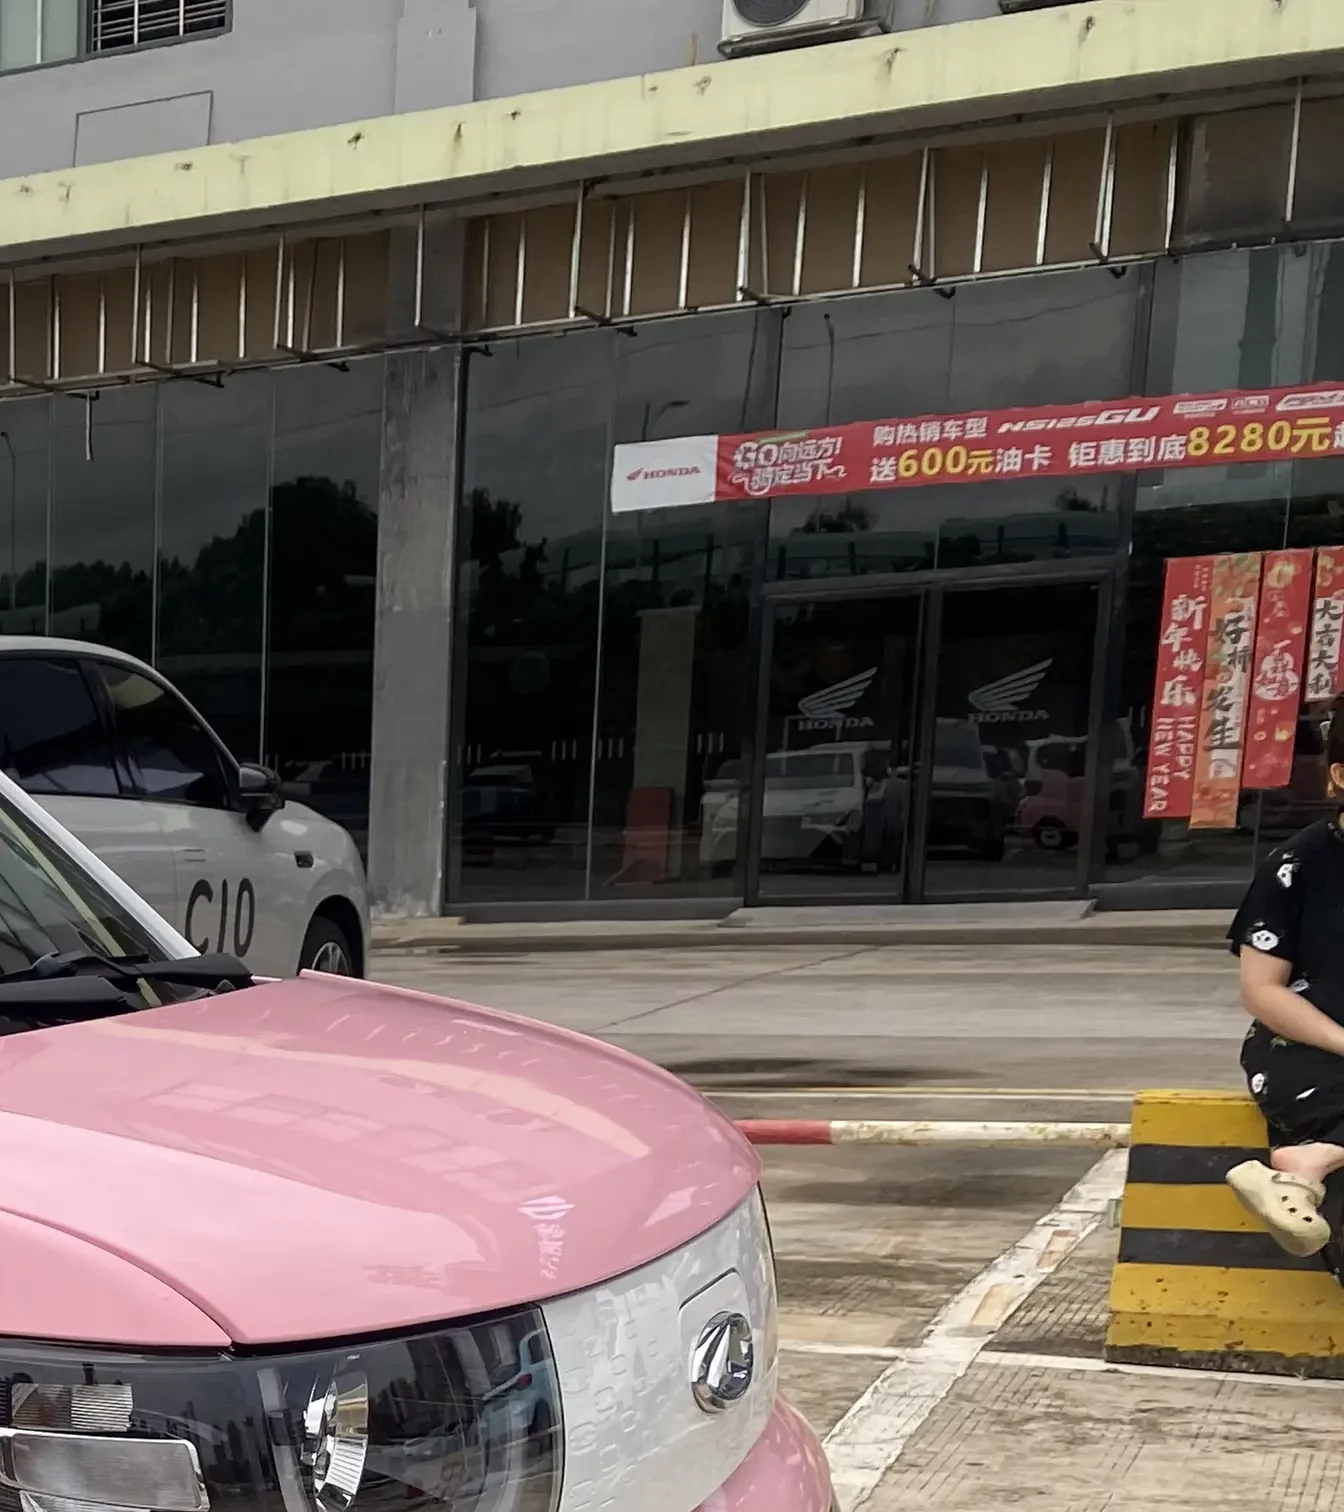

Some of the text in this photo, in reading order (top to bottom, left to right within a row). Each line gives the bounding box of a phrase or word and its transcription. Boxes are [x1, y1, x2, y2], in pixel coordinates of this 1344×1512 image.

[872, 416, 989, 446] 购热销车型
[643, 465, 702, 480] HONDA
[869, 444, 1053, 483] 送600元油卡
[1159, 593, 1208, 706] 新年快乐
[798, 716, 875, 731] HONDA
[968, 709, 1050, 724] HONDA
[1172, 715, 1197, 780] HAPPY
